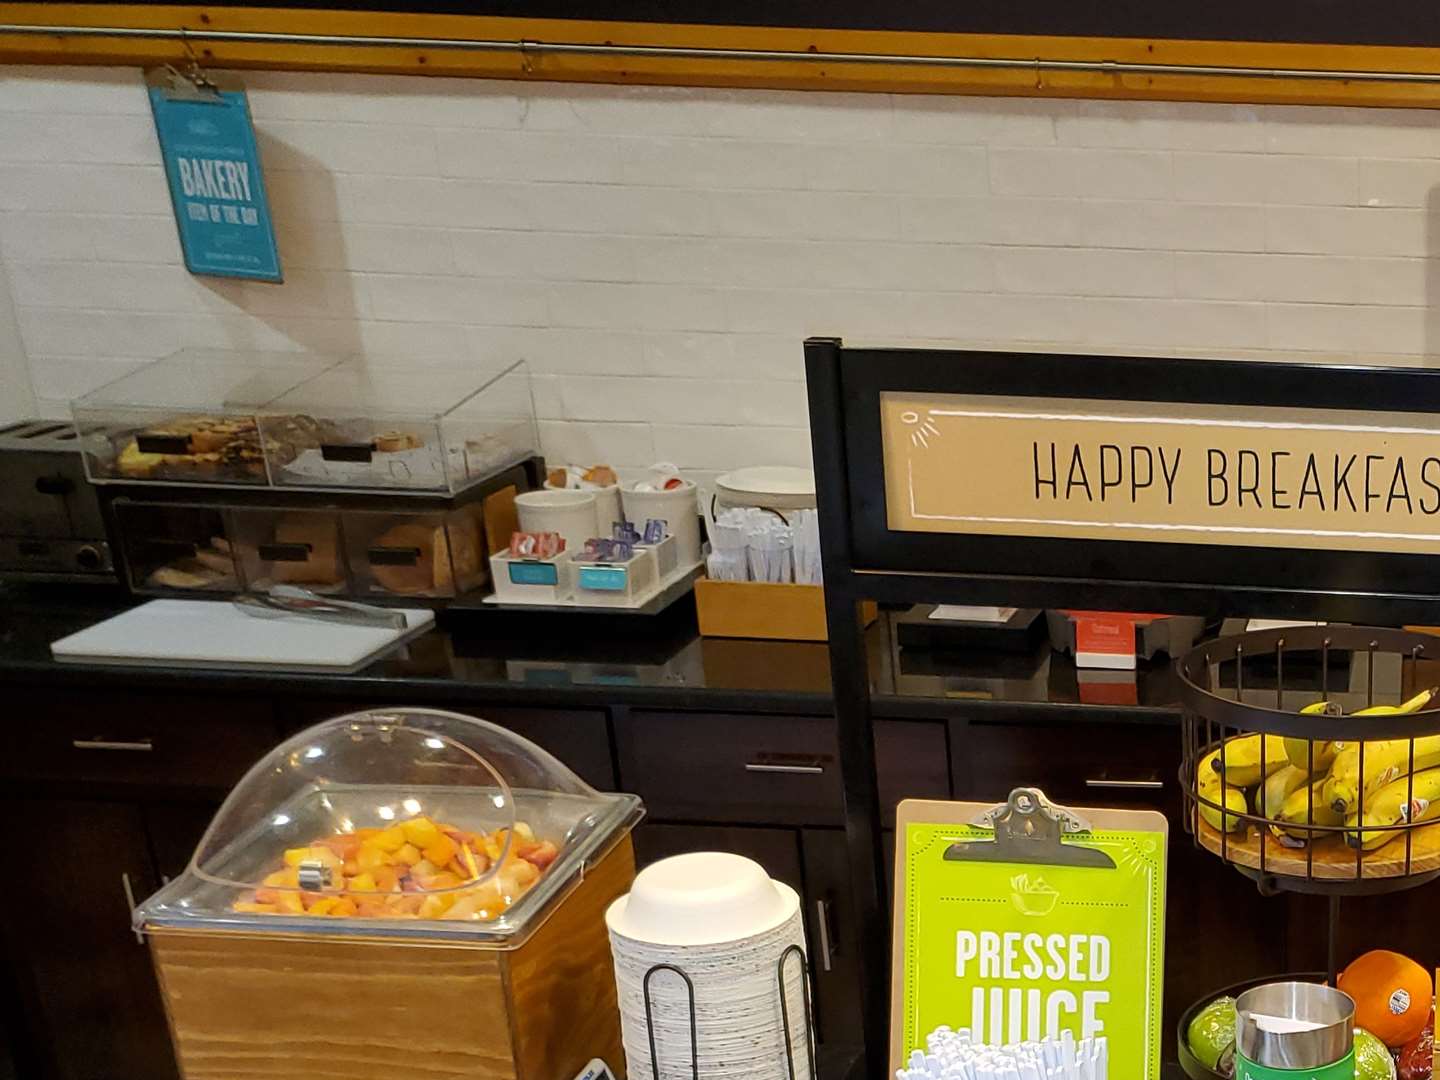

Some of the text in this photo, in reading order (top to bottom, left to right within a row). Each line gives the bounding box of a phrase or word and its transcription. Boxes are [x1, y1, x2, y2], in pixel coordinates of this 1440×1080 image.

[178, 158, 251, 201] BAKERY
[1033, 440, 1182, 505] HAPPY
[955, 930, 1111, 982] PRESSED
[972, 987, 1111, 1046] JUICE
